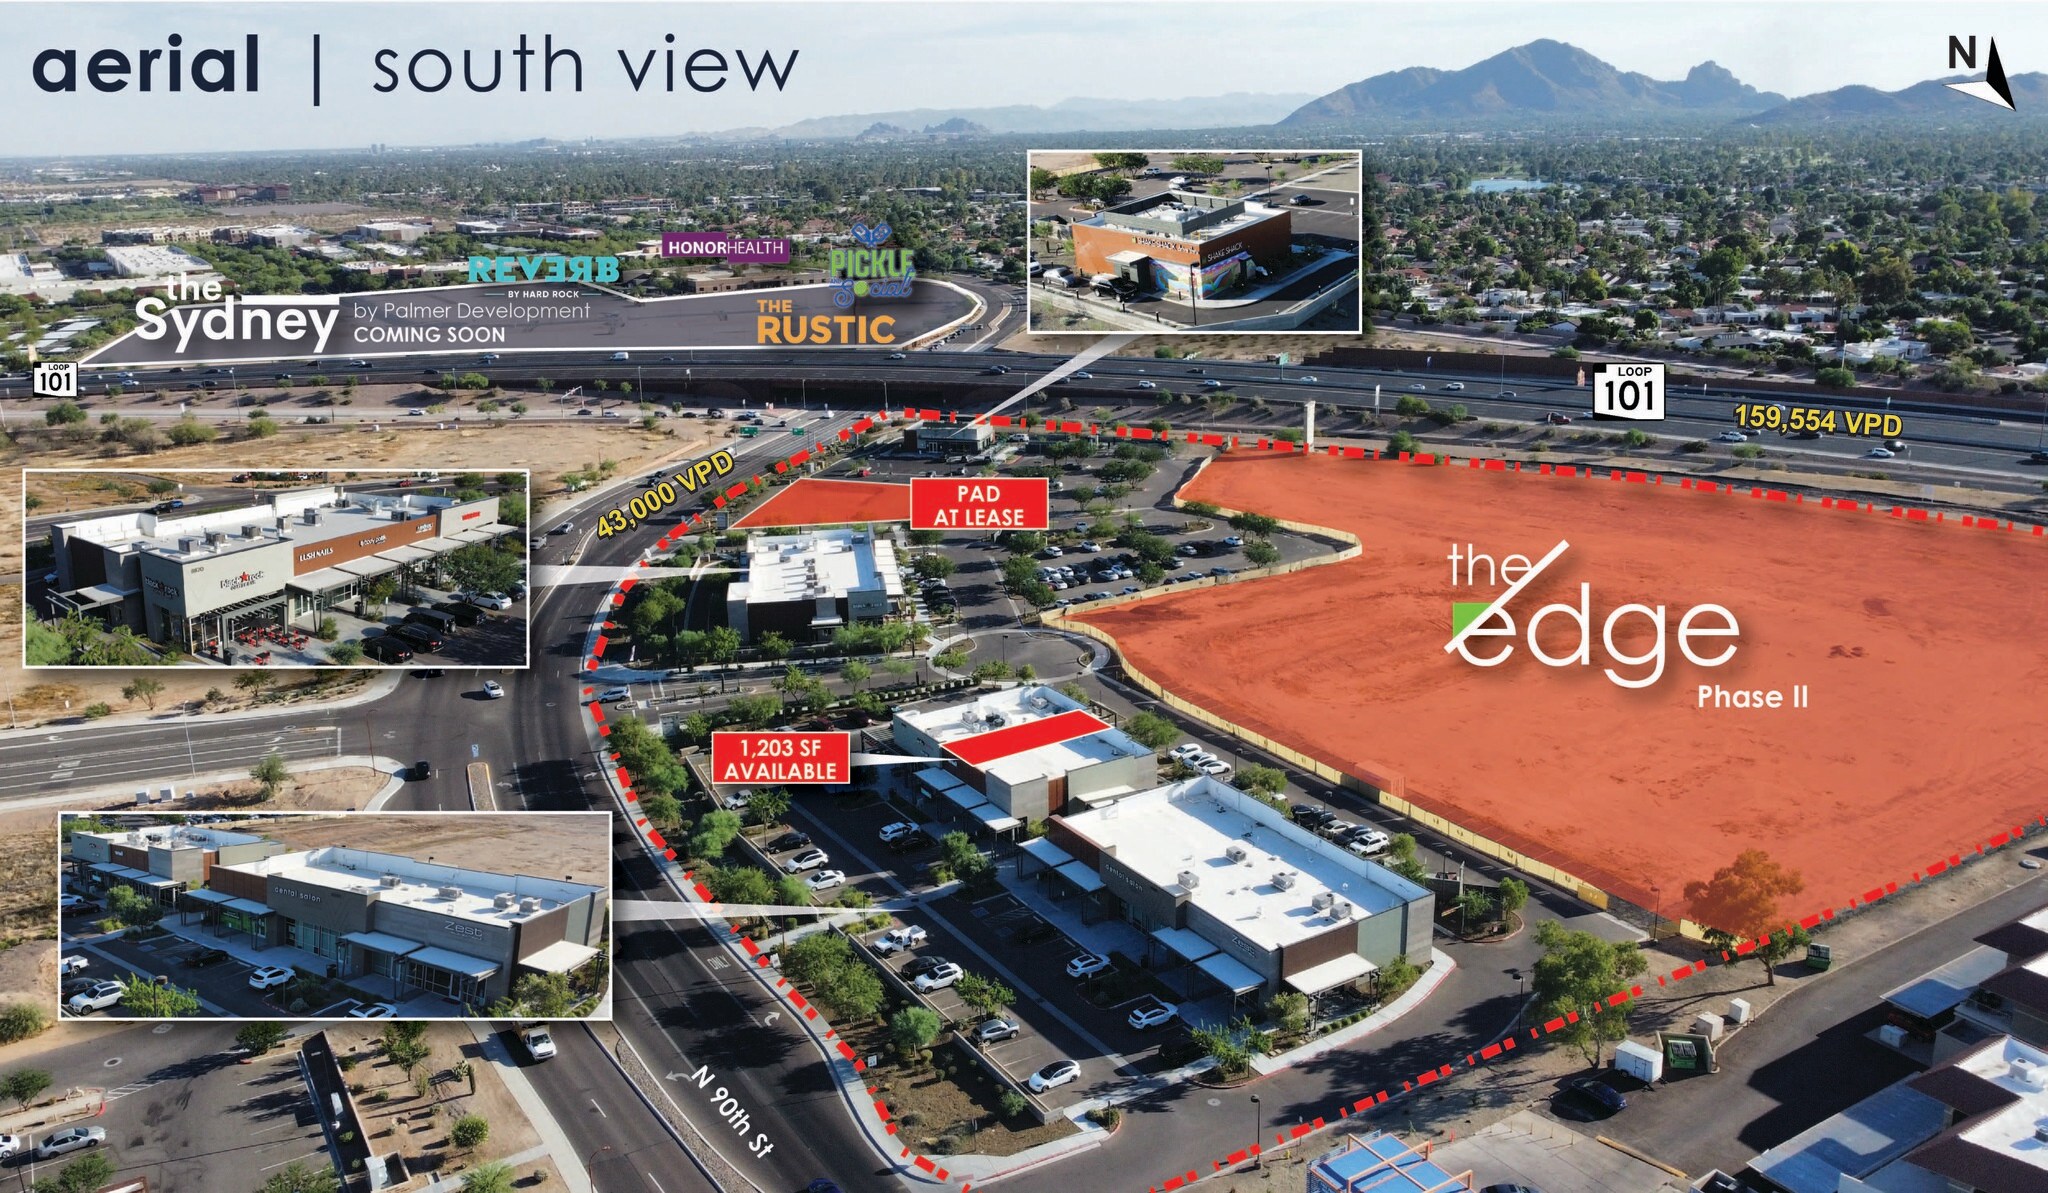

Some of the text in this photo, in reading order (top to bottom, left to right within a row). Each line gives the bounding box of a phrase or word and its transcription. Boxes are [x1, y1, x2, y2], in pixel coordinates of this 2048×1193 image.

[1207, 248, 1226, 262] SHAKE
[1225, 241, 1244, 255] SHACK
[299, 547, 334, 562] LUSH NAILS
[274, 885, 322, 904] dental salon
[444, 920, 483, 937] Zest
[707, 955, 732, 970] ONLY
